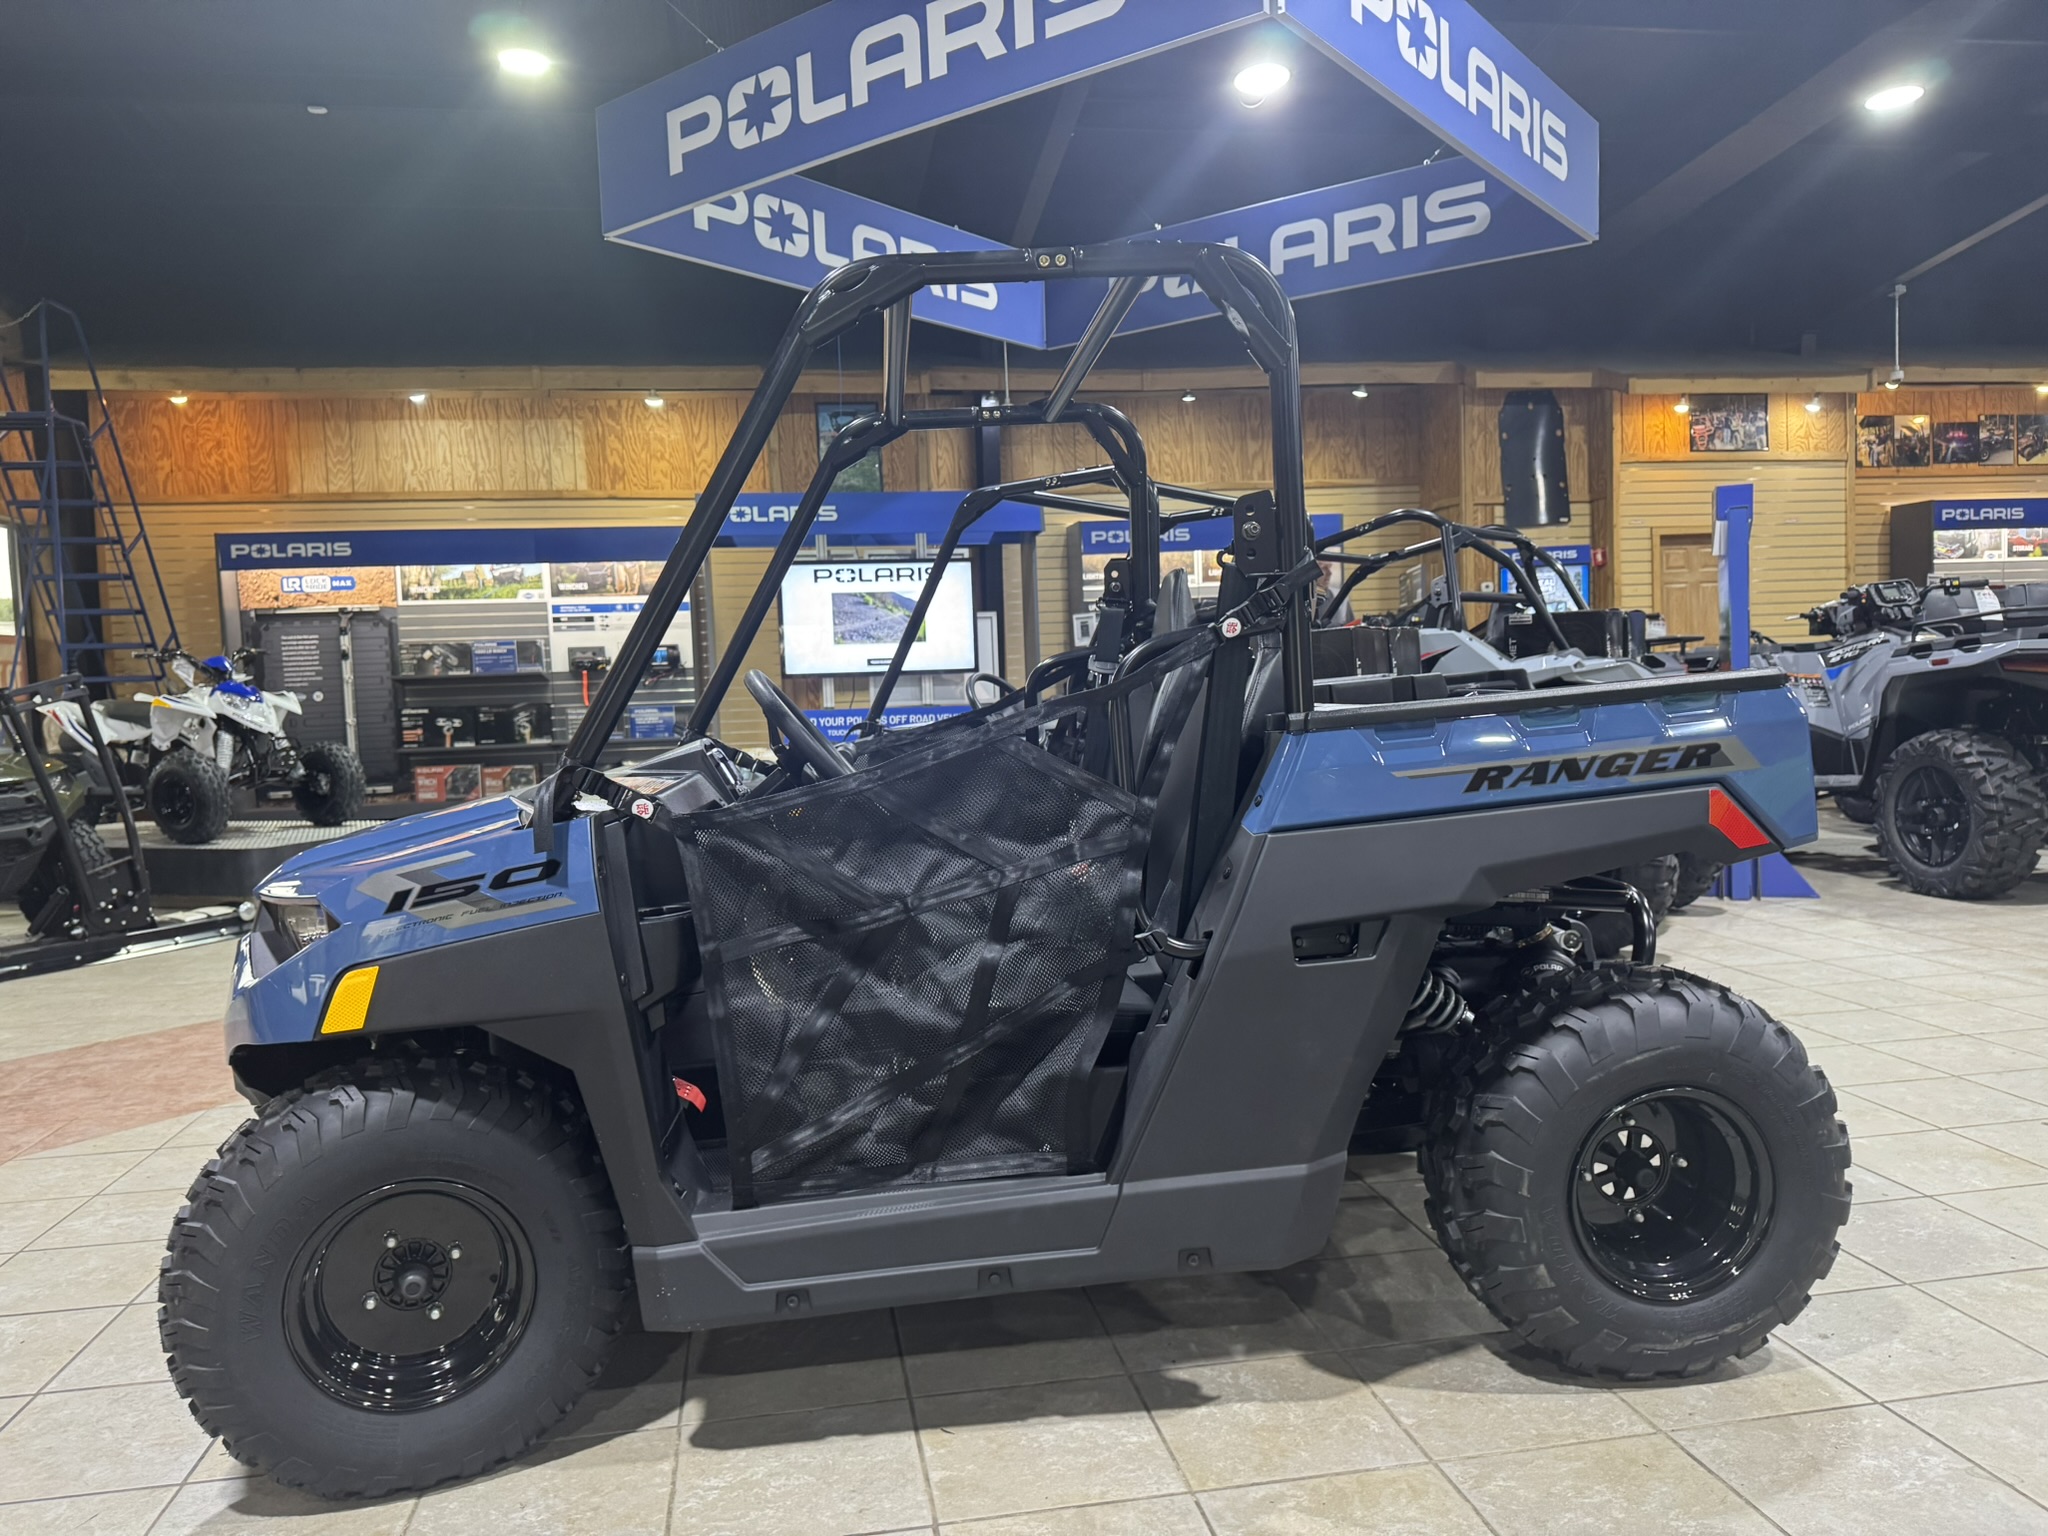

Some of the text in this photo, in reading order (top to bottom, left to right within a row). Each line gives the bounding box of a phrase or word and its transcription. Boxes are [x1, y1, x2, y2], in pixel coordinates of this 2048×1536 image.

[1941, 507, 2025, 521] POLARIS
[230, 542, 352, 559] POLARIS
[818, 716, 845, 727] YOUR
[889, 714, 907, 724] OFF
[909, 713, 936, 723] ROAD
[1461, 742, 1721, 794] RANGER
[383, 858, 561, 915] 150
[460, 905, 491, 917] FUEL
[500, 891, 563, 910] INJECTION
